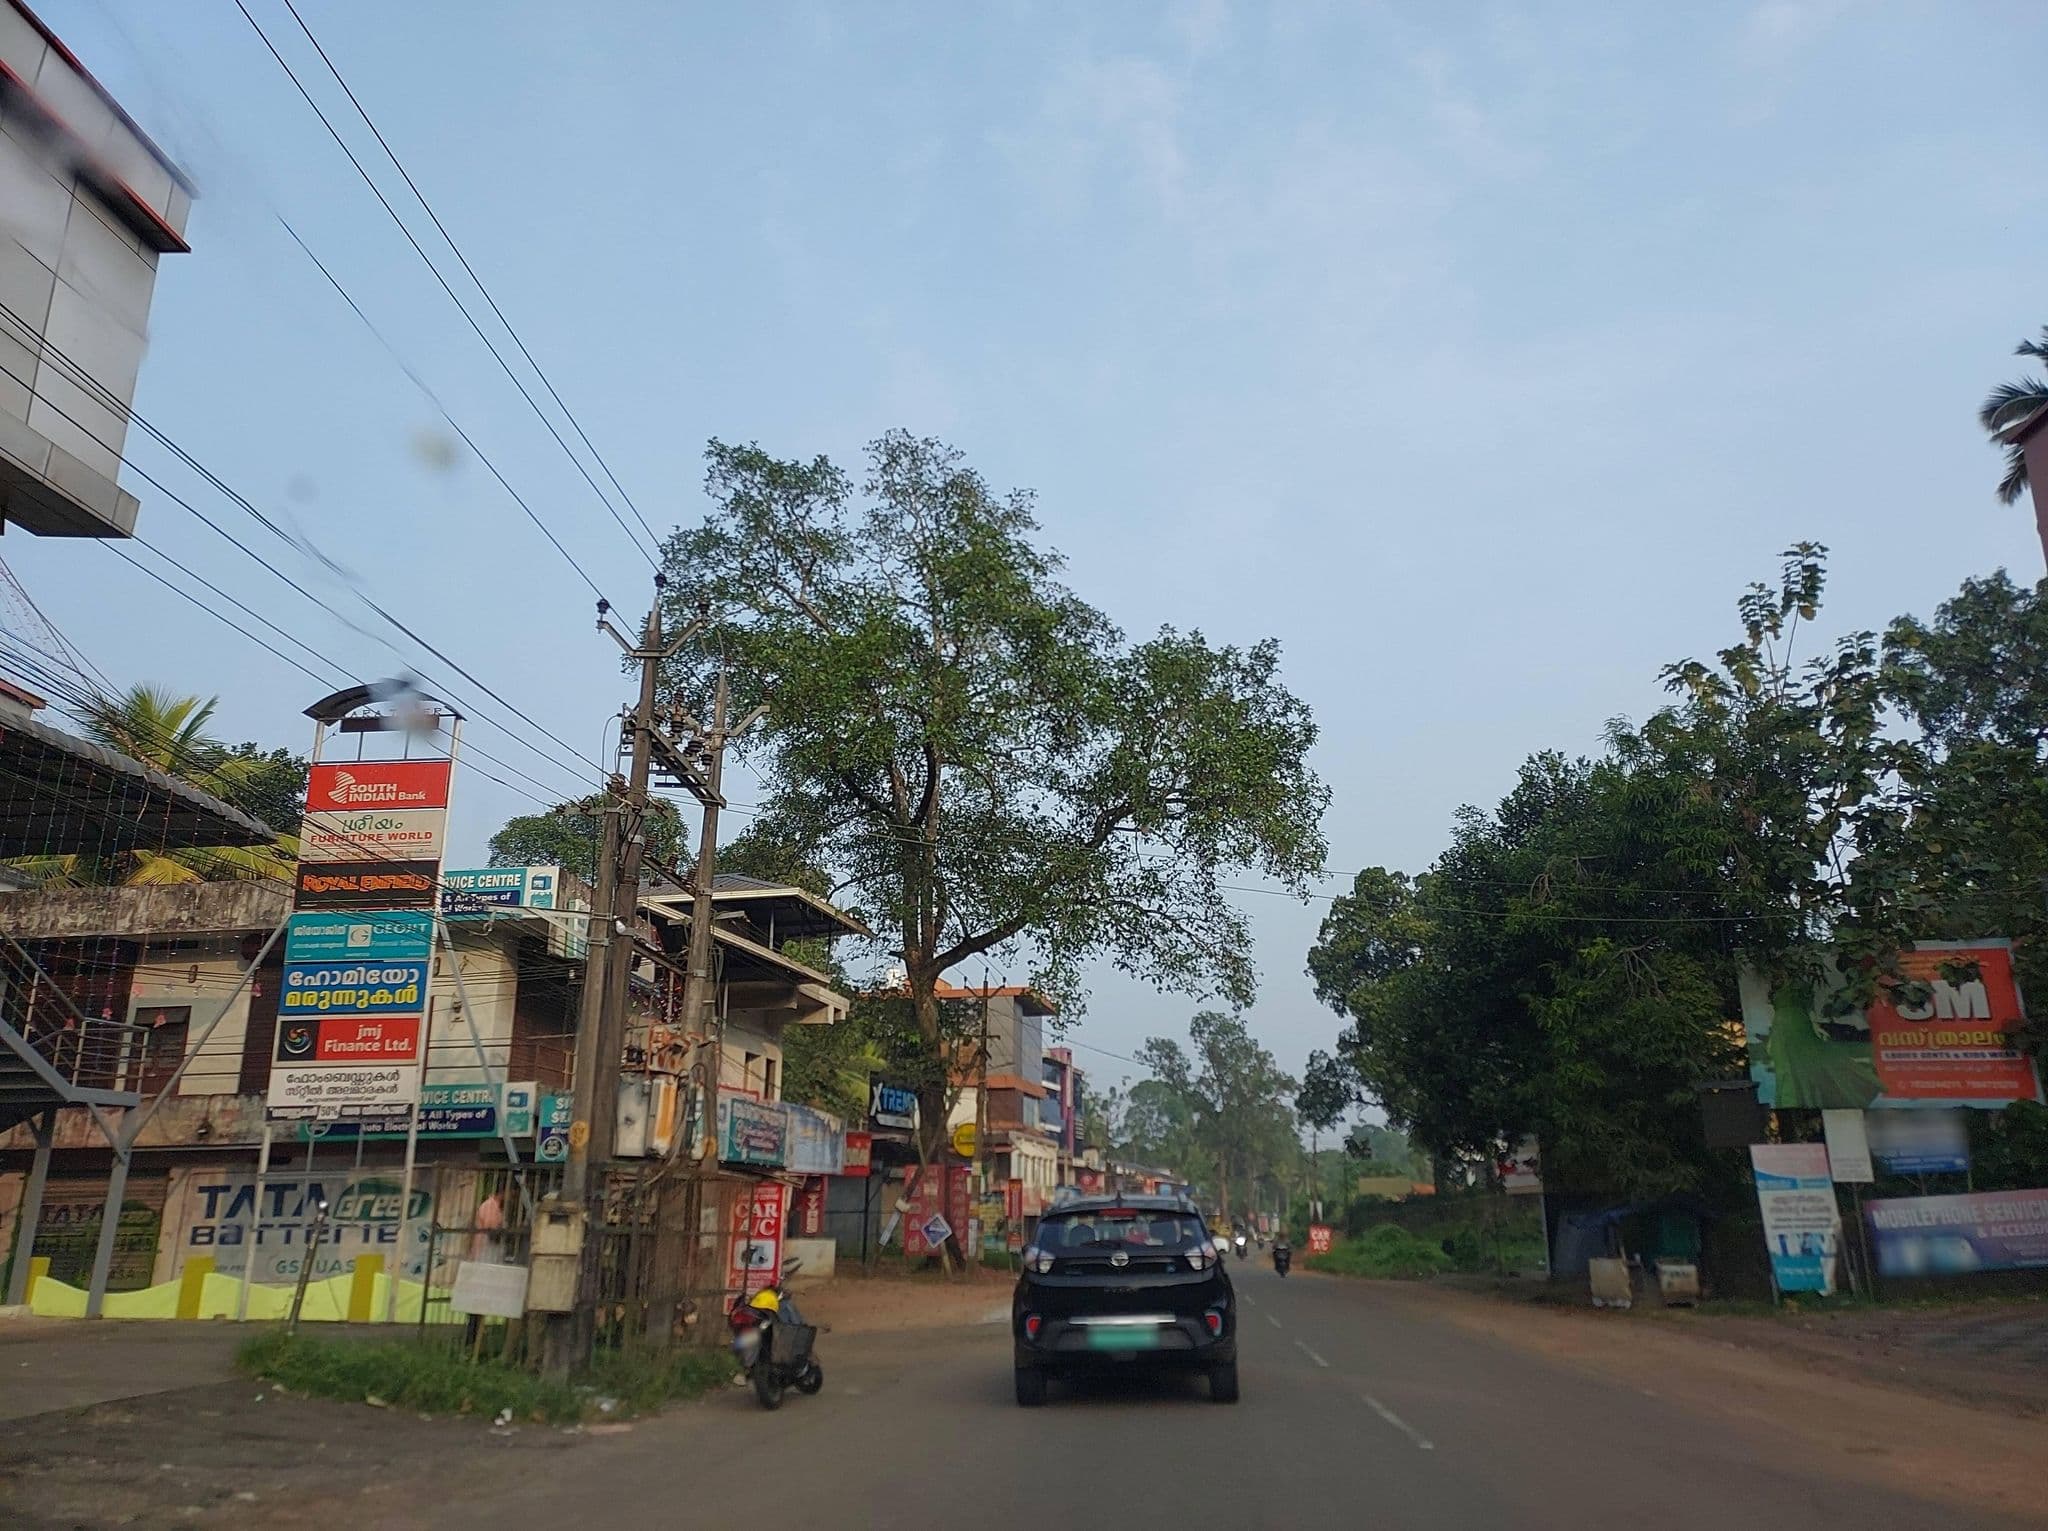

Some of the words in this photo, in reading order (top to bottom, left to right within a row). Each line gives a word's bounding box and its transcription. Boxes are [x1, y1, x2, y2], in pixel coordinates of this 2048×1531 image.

[349, 783, 397, 793] SOUTH
[348, 793, 396, 802] INDIAN
[398, 791, 427, 801] Bank
[310, 834, 385, 843] FURNITURE
[388, 832, 432, 841] WORLD
[303, 875, 360, 893] ROYAL
[360, 874, 431, 892] ENFIELD
[477, 874, 522, 888] CENTRE
[500, 892, 512, 901] of
[288, 967, 420, 987] ഹോമിയോ
[285, 984, 418, 1009] മരുന്നുകൾ
[356, 1023, 383, 1041] jmj
[324, 1038, 382, 1053] Finance
[384, 1038, 413, 1052] Ltd.
[1962, 1051, 1987, 1059] KIDS
[428, 1110, 443, 1119] All
[445, 1109, 474, 1121] Types
[475, 1108, 488, 1119] of
[428, 1121, 460, 1131] Works
[197, 1182, 329, 1220] TATA
[336, 1190, 422, 1219] Green
[736, 1202, 778, 1218] CAR
[740, 1218, 776, 1237] A/C
[1311, 1229, 1331, 1240] CAR
[275, 1259, 299, 1275] GS
[315, 1258, 355, 1274] UAS
